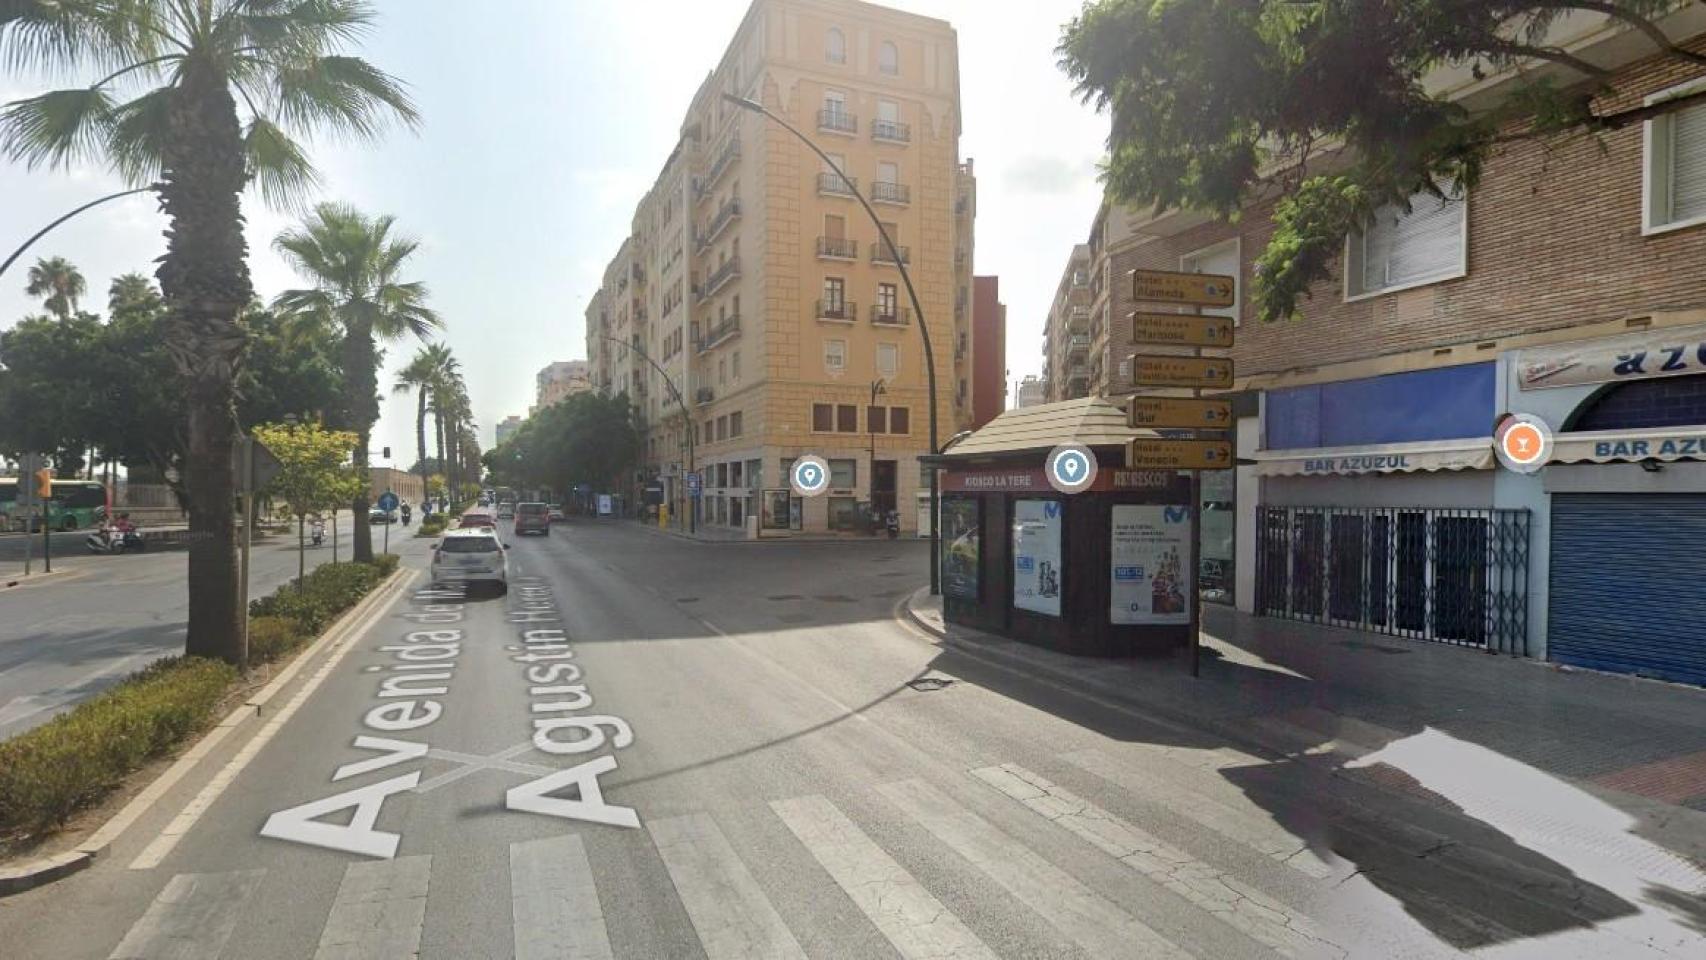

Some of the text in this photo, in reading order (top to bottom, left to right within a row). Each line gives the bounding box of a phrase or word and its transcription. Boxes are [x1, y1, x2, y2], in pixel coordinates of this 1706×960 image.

[1595, 440, 1649, 457] BAR
[1304, 455, 1411, 473] BAR AZUZUL
